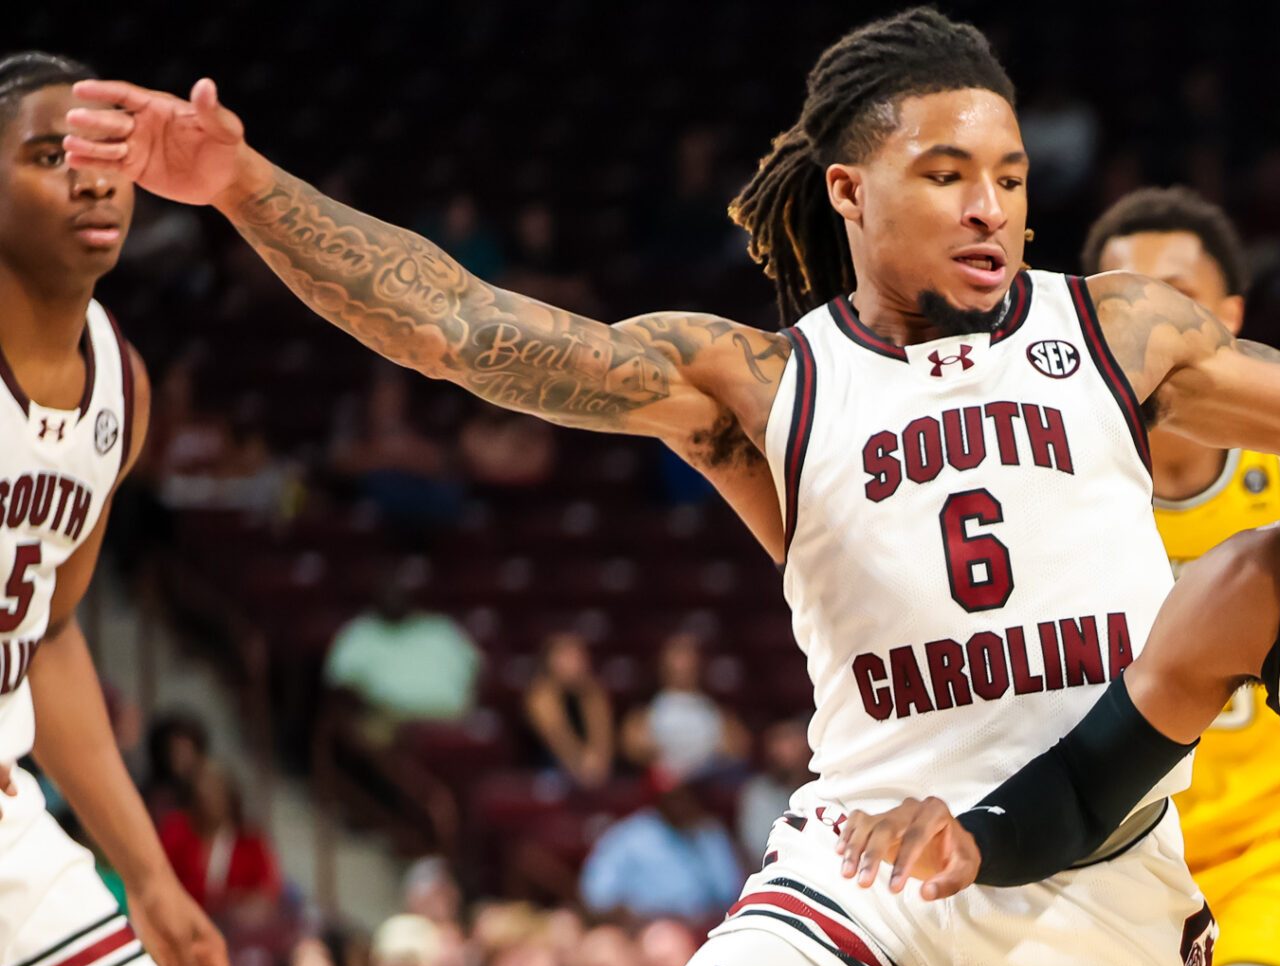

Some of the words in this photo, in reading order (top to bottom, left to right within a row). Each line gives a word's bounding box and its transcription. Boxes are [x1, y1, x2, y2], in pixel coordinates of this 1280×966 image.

[377, 256, 448, 314] One
[472, 322, 583, 371] Beat
[1031, 342, 1078, 376] SEC
[862, 400, 1075, 503] SOUTH
[938, 487, 1015, 614] 6
[852, 612, 1134, 722] CAROLINA
